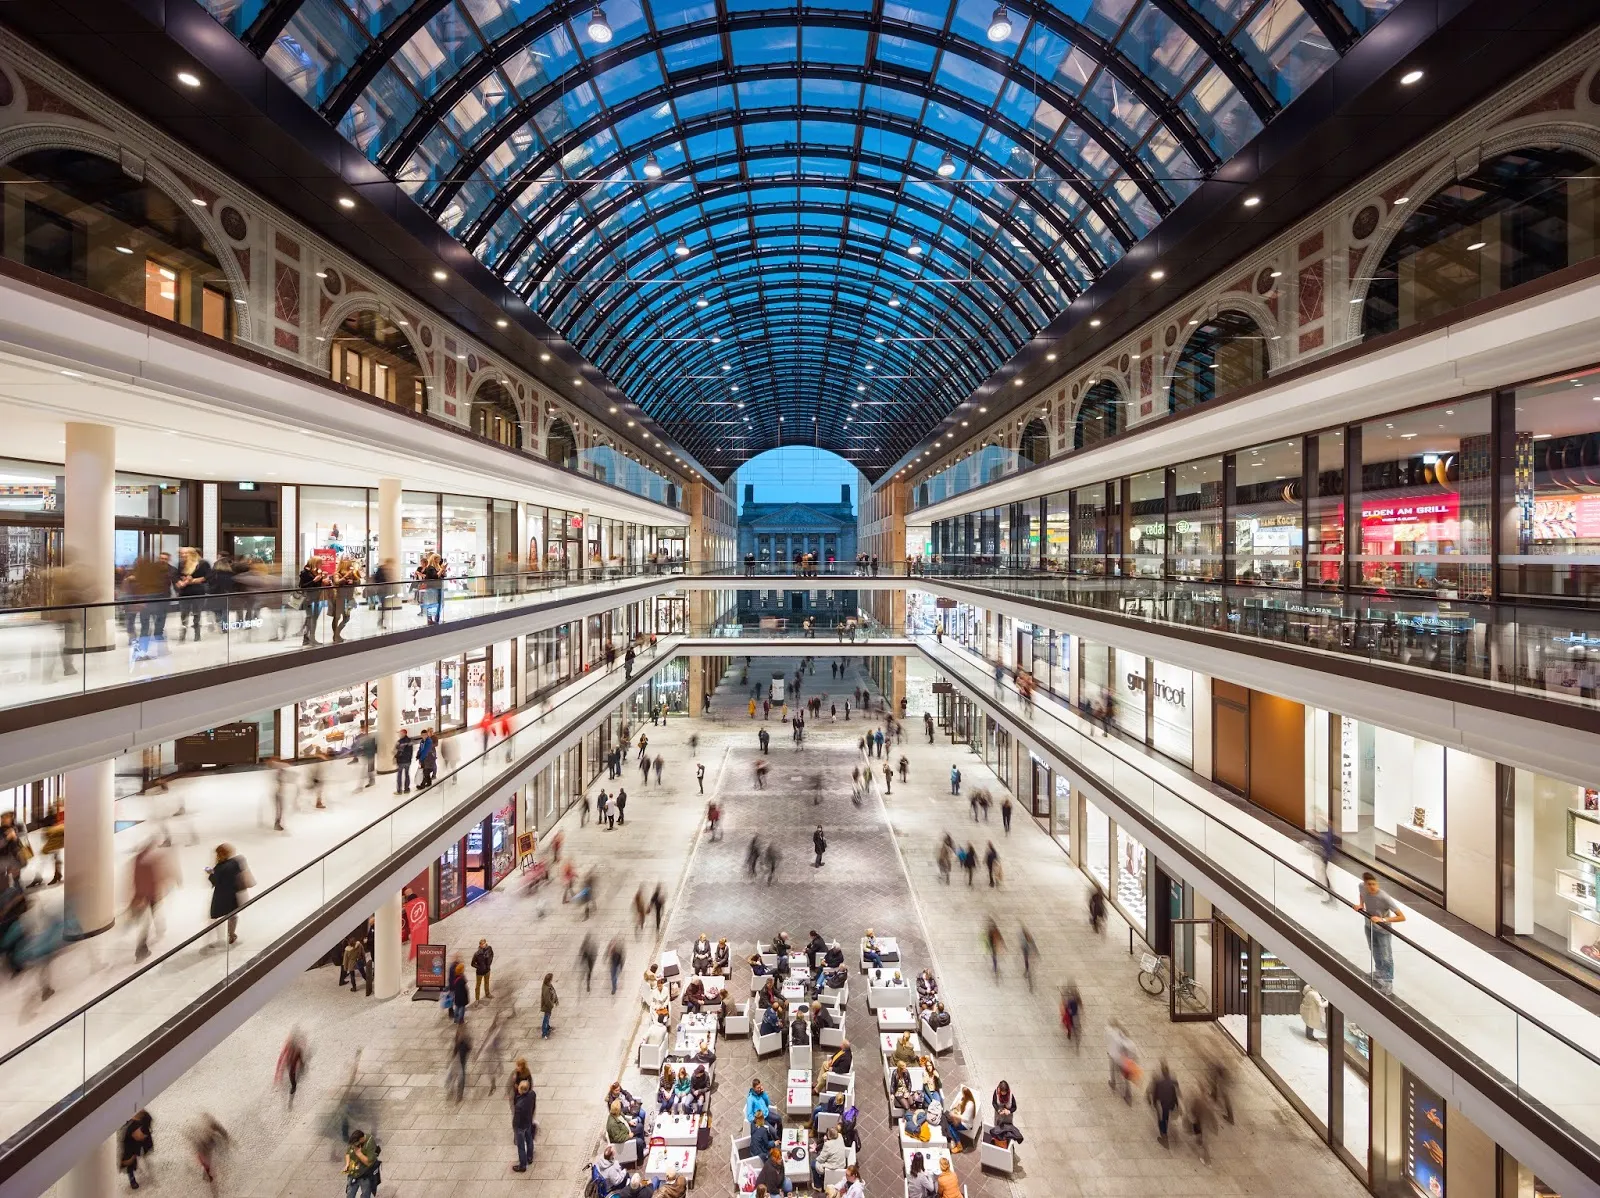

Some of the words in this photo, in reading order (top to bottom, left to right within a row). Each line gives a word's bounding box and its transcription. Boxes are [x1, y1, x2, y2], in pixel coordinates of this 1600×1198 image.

[1416, 505, 1449, 514] GRILL
[1127, 670, 1146, 691] gin
[1153, 678, 1186, 707] tricot
